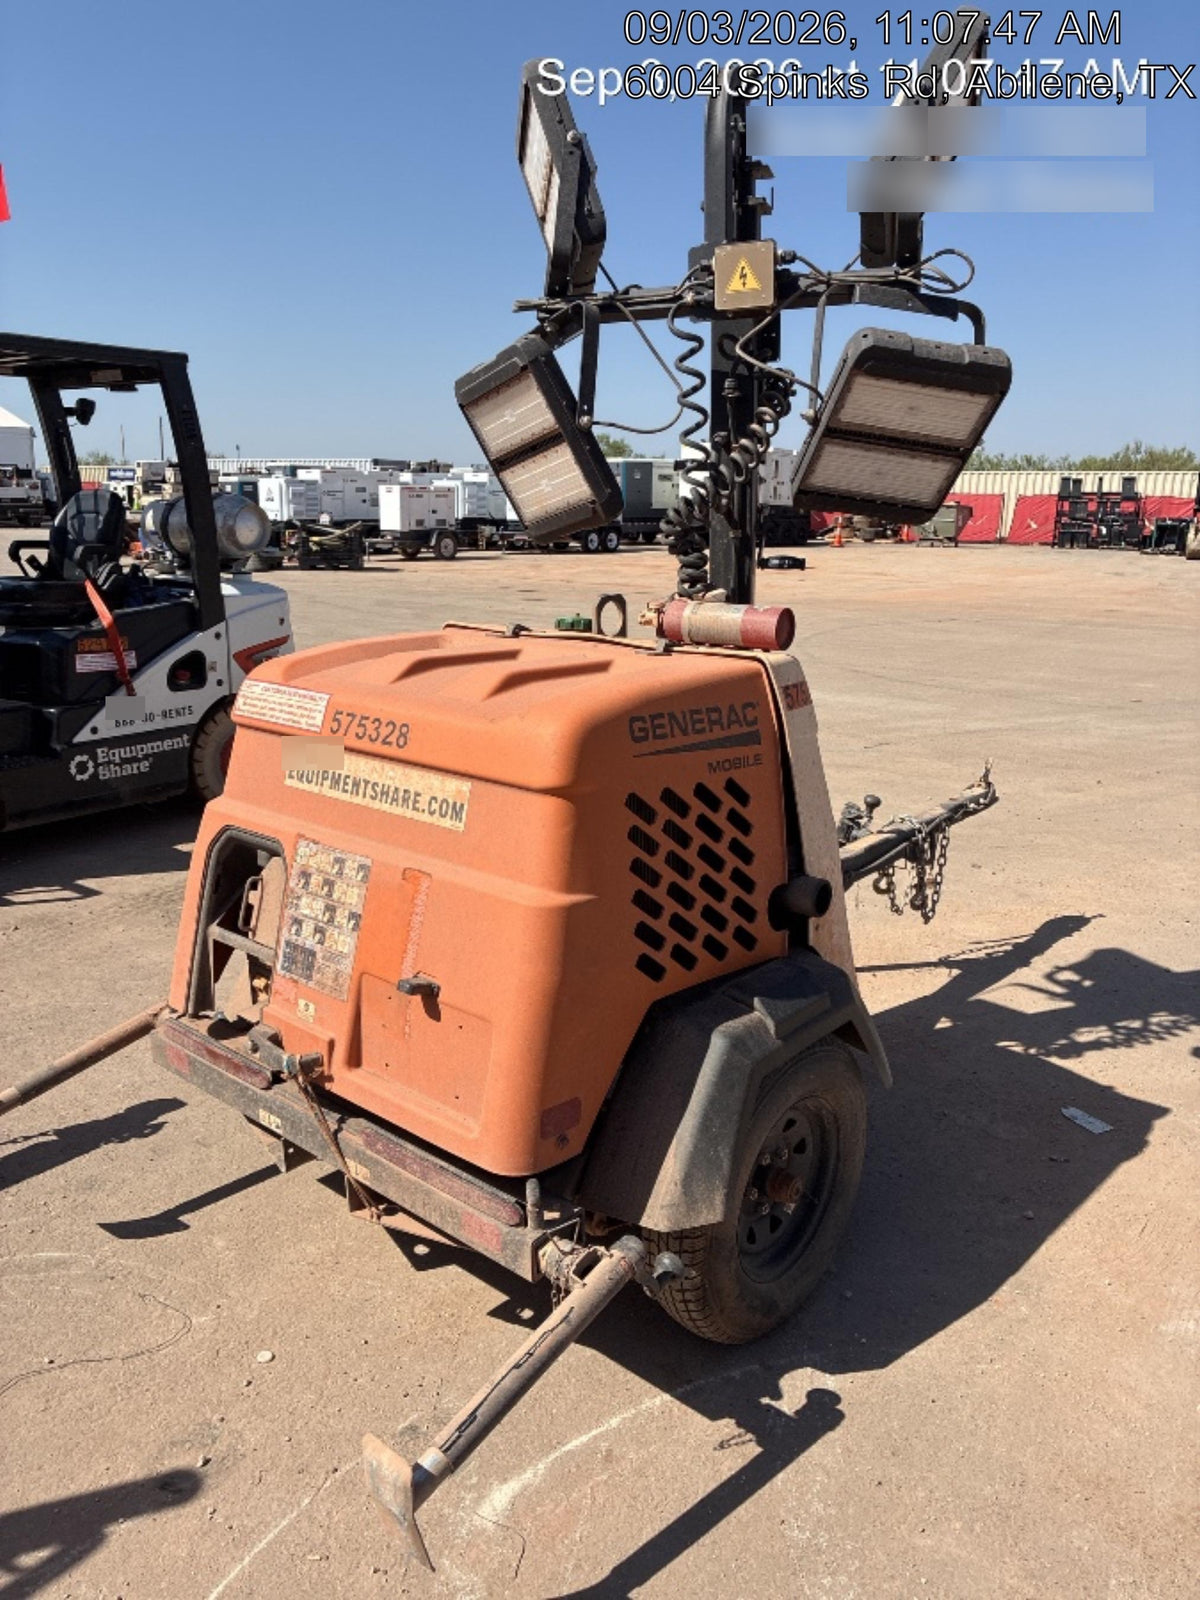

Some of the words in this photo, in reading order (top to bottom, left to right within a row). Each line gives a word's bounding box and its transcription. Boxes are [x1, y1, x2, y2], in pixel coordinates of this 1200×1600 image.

[329, 709, 410, 749] 575328
[628, 702, 759, 744] GENERAC
[96, 733, 191, 763] Equipment
[707, 754, 763, 774] MOBILE
[98, 760, 151, 780] Share
[286, 769, 466, 823] EQUIPMENTSHARE.COM
